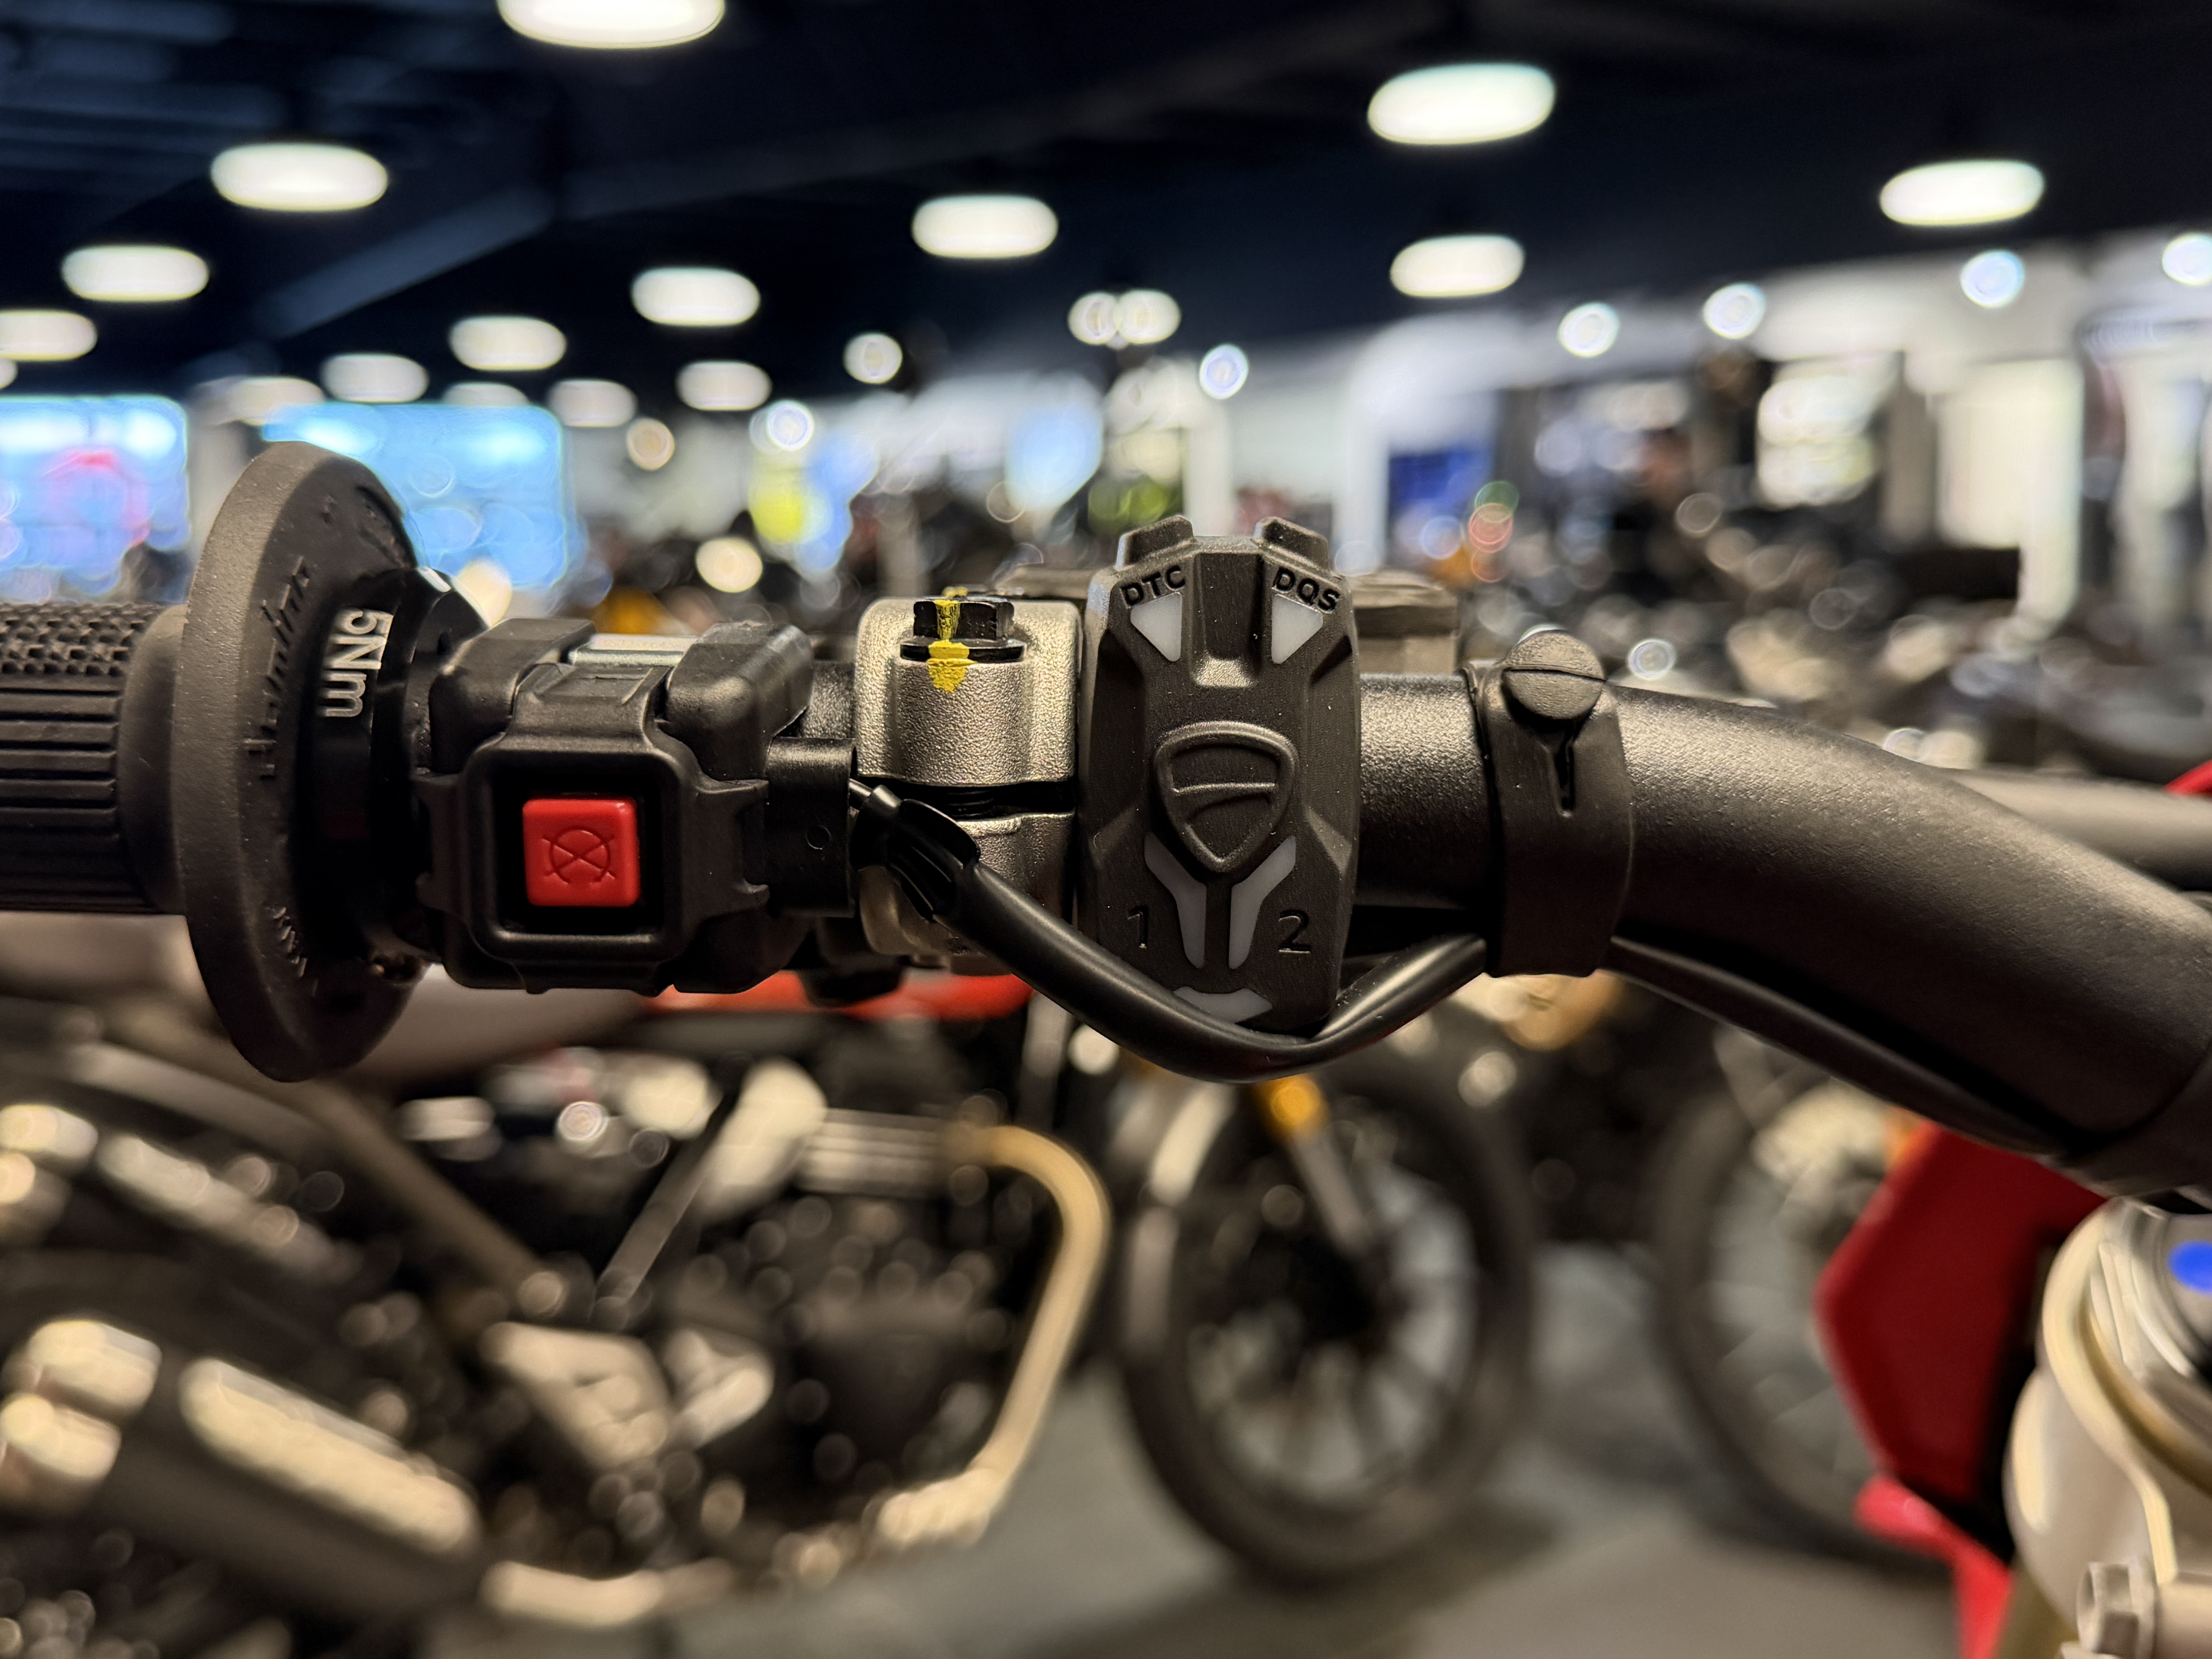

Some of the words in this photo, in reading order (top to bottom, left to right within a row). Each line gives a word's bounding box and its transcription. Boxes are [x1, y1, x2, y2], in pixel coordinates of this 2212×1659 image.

[1120, 564, 1186, 609] DTC
[1272, 567, 1340, 613] DQS
[322, 607, 393, 718] 5Nm
[1127, 905, 1149, 950] 1
[1278, 909, 1311, 955] 2
